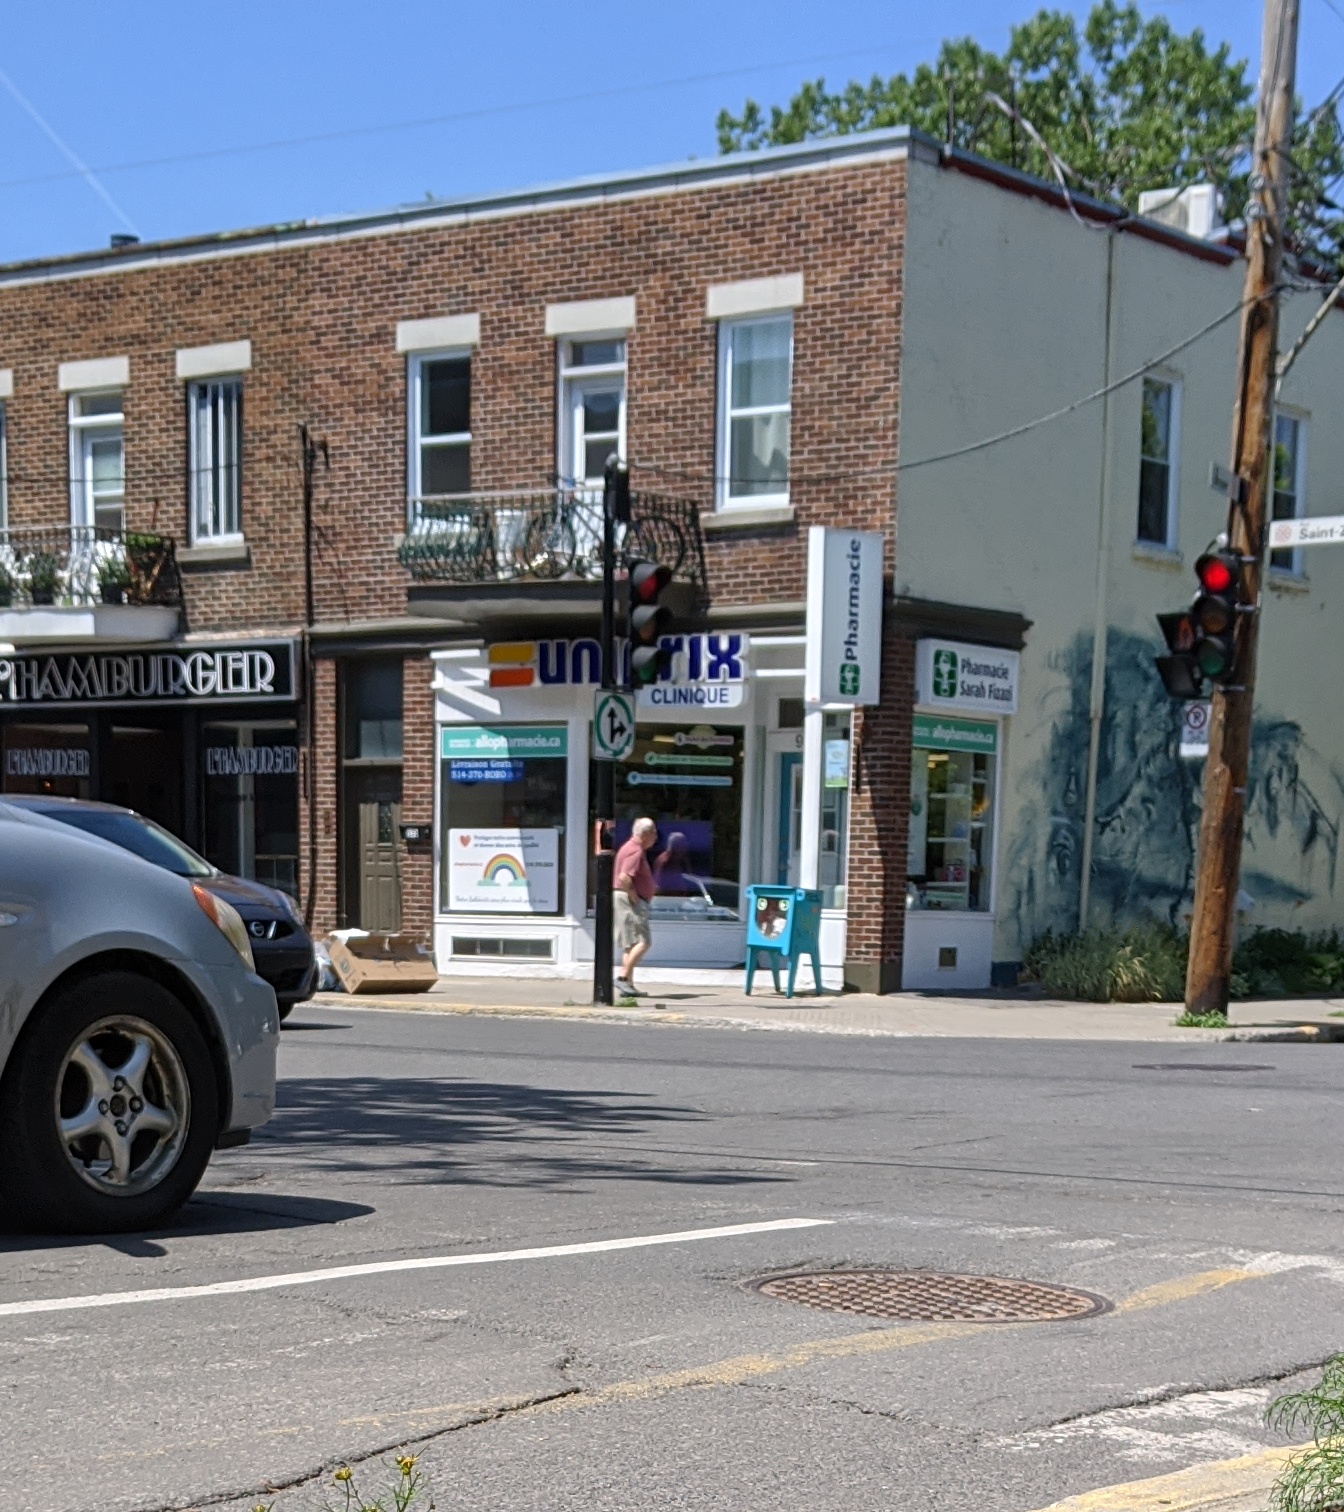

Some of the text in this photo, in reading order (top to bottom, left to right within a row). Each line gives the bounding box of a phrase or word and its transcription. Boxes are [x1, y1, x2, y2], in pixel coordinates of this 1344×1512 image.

[844, 538, 861, 661] Pharmacie
[960, 657, 1009, 680] Pharmacie
[651, 687, 730, 705] CLINIQUE
[959, 680, 986, 698] Sarah
